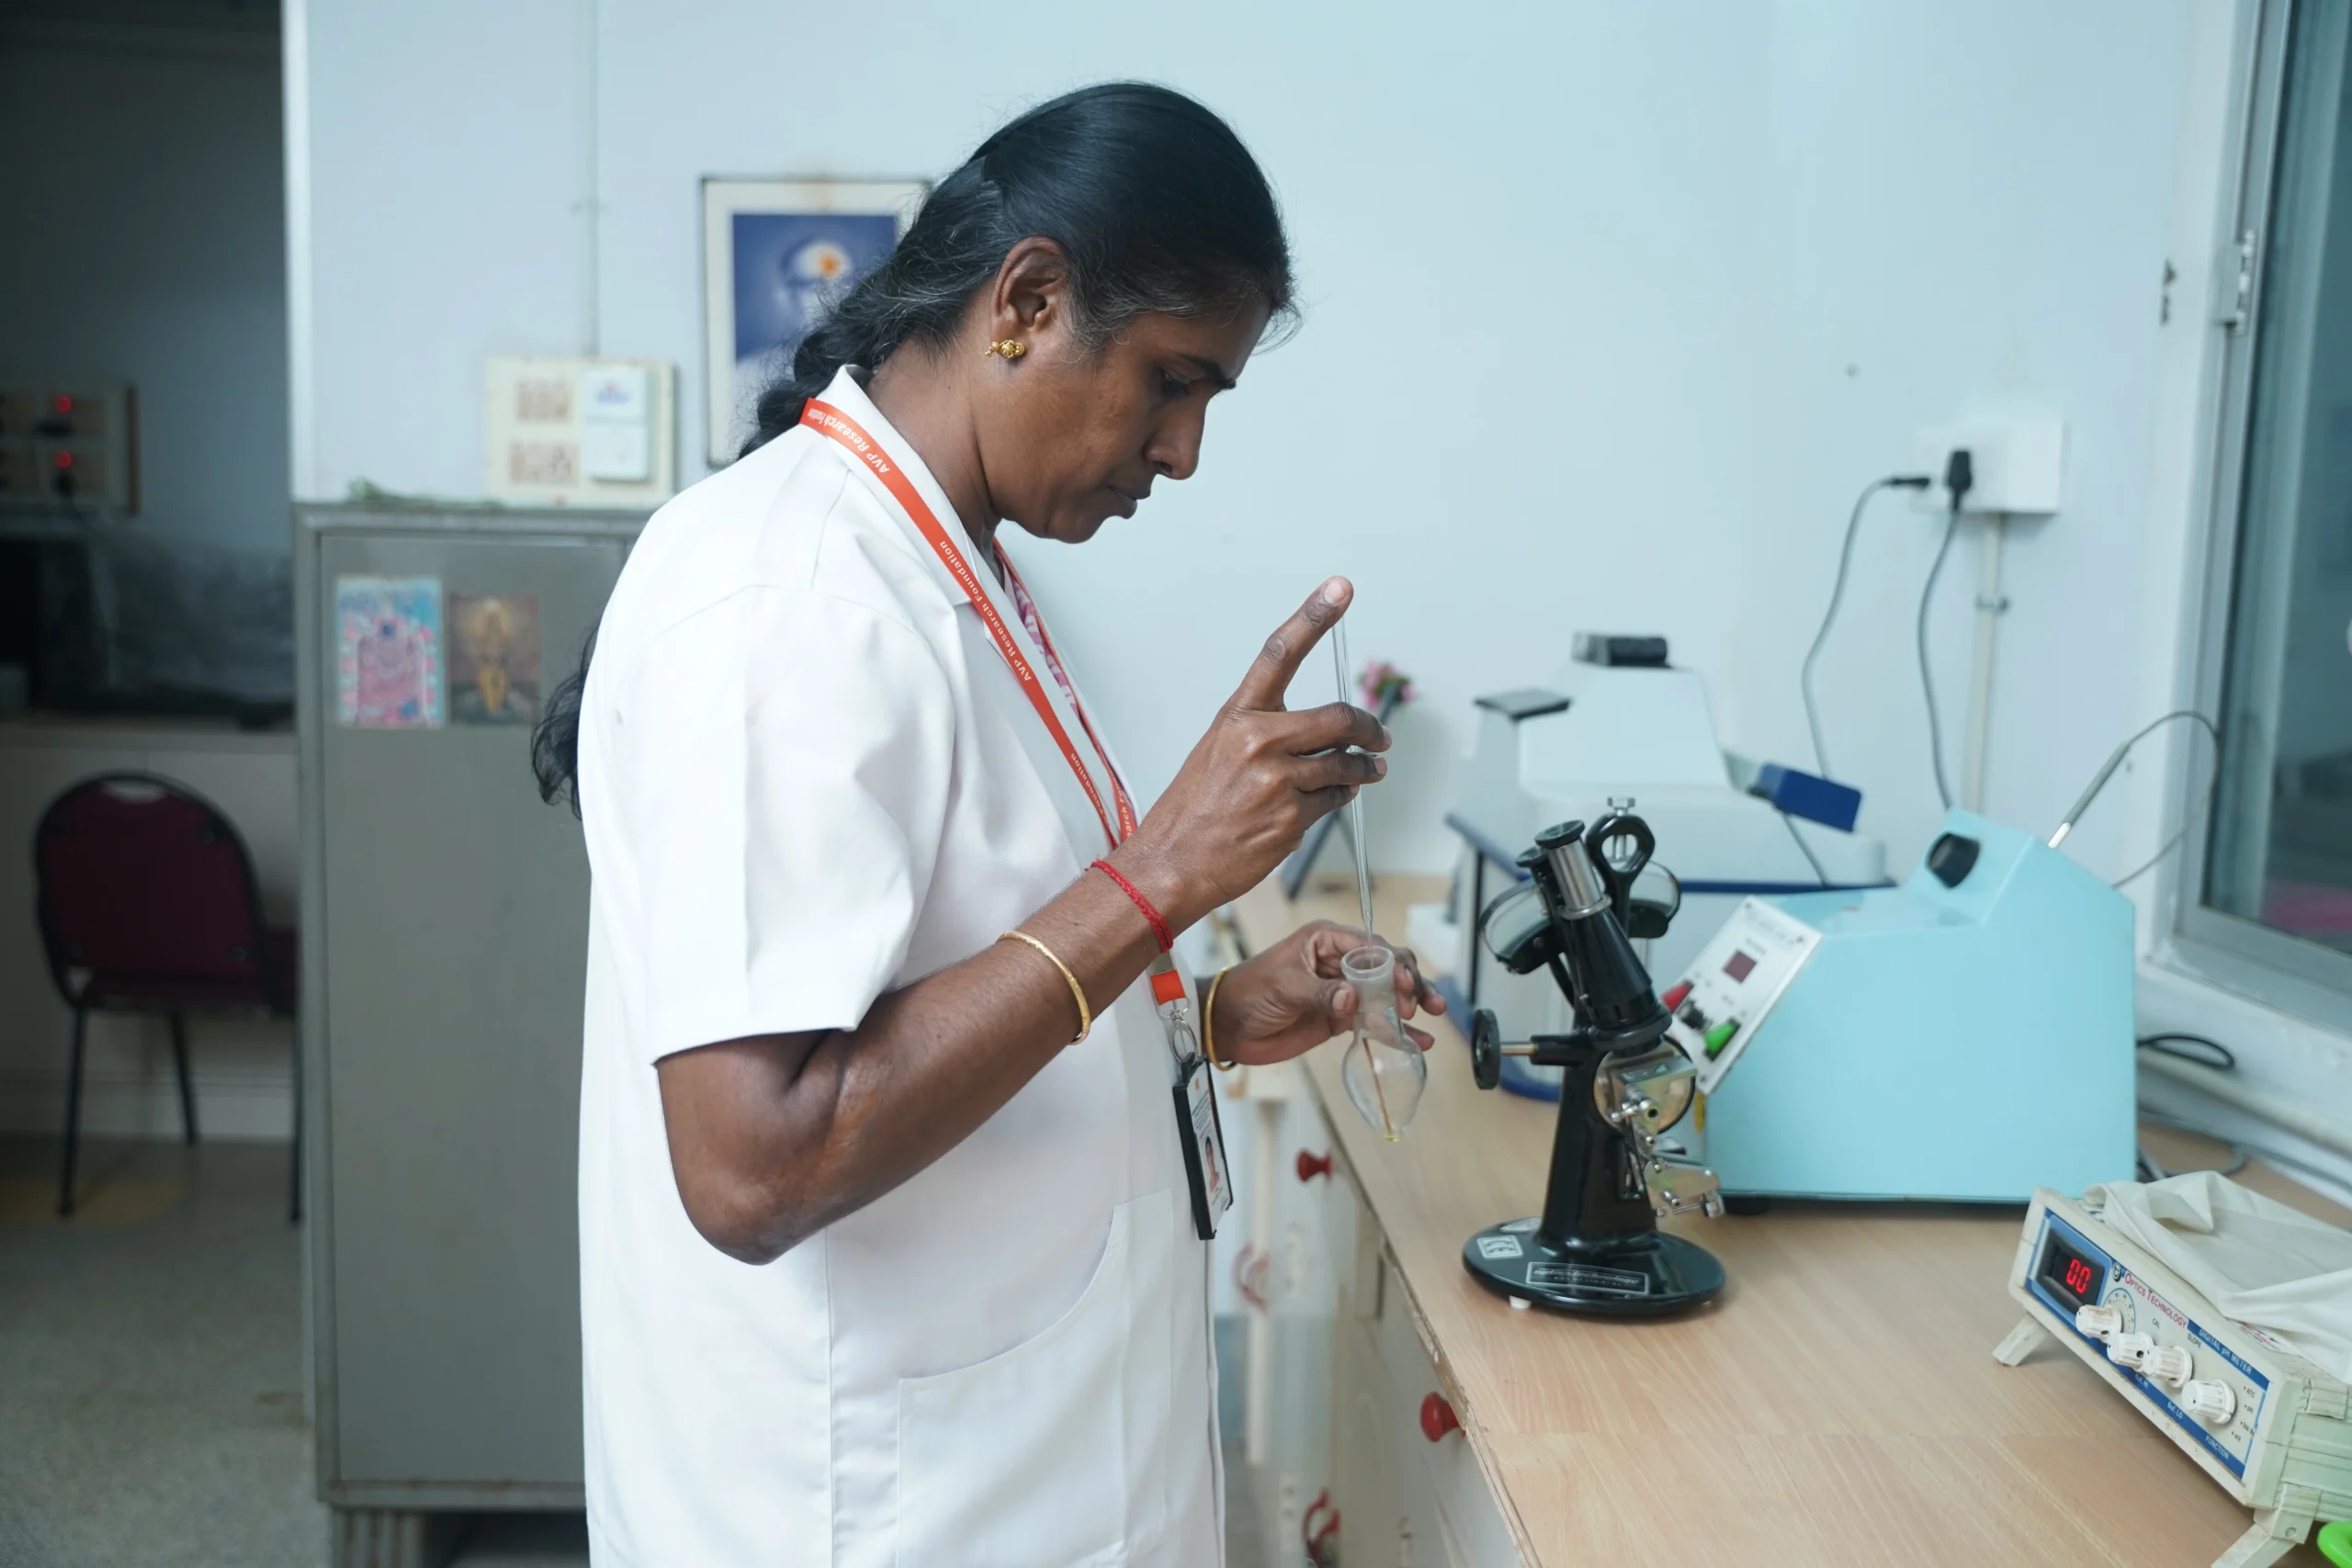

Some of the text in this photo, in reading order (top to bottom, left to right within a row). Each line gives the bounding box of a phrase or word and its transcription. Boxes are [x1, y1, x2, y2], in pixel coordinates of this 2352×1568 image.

[824, 414, 870, 452] Research
[866, 453, 890, 473] AVP
[939, 540, 1032, 682] AVP Research Foundation
[2066, 1258, 2092, 1294] 00
[2124, 1272, 2145, 1297] OPTICS
[2147, 1289, 2188, 1328] TECHNOLOGY
[2152, 1318, 2160, 1329] CAL
[2187, 1334, 2201, 1348] SLOPE
[2199, 1328, 2221, 1350] DIGITAL
[2221, 1348, 2231, 1358] pH
[2231, 1352, 2252, 1375] METER
[2176, 1409, 2183, 1419] LO
[2205, 1435, 2230, 1460] FUNCTION
